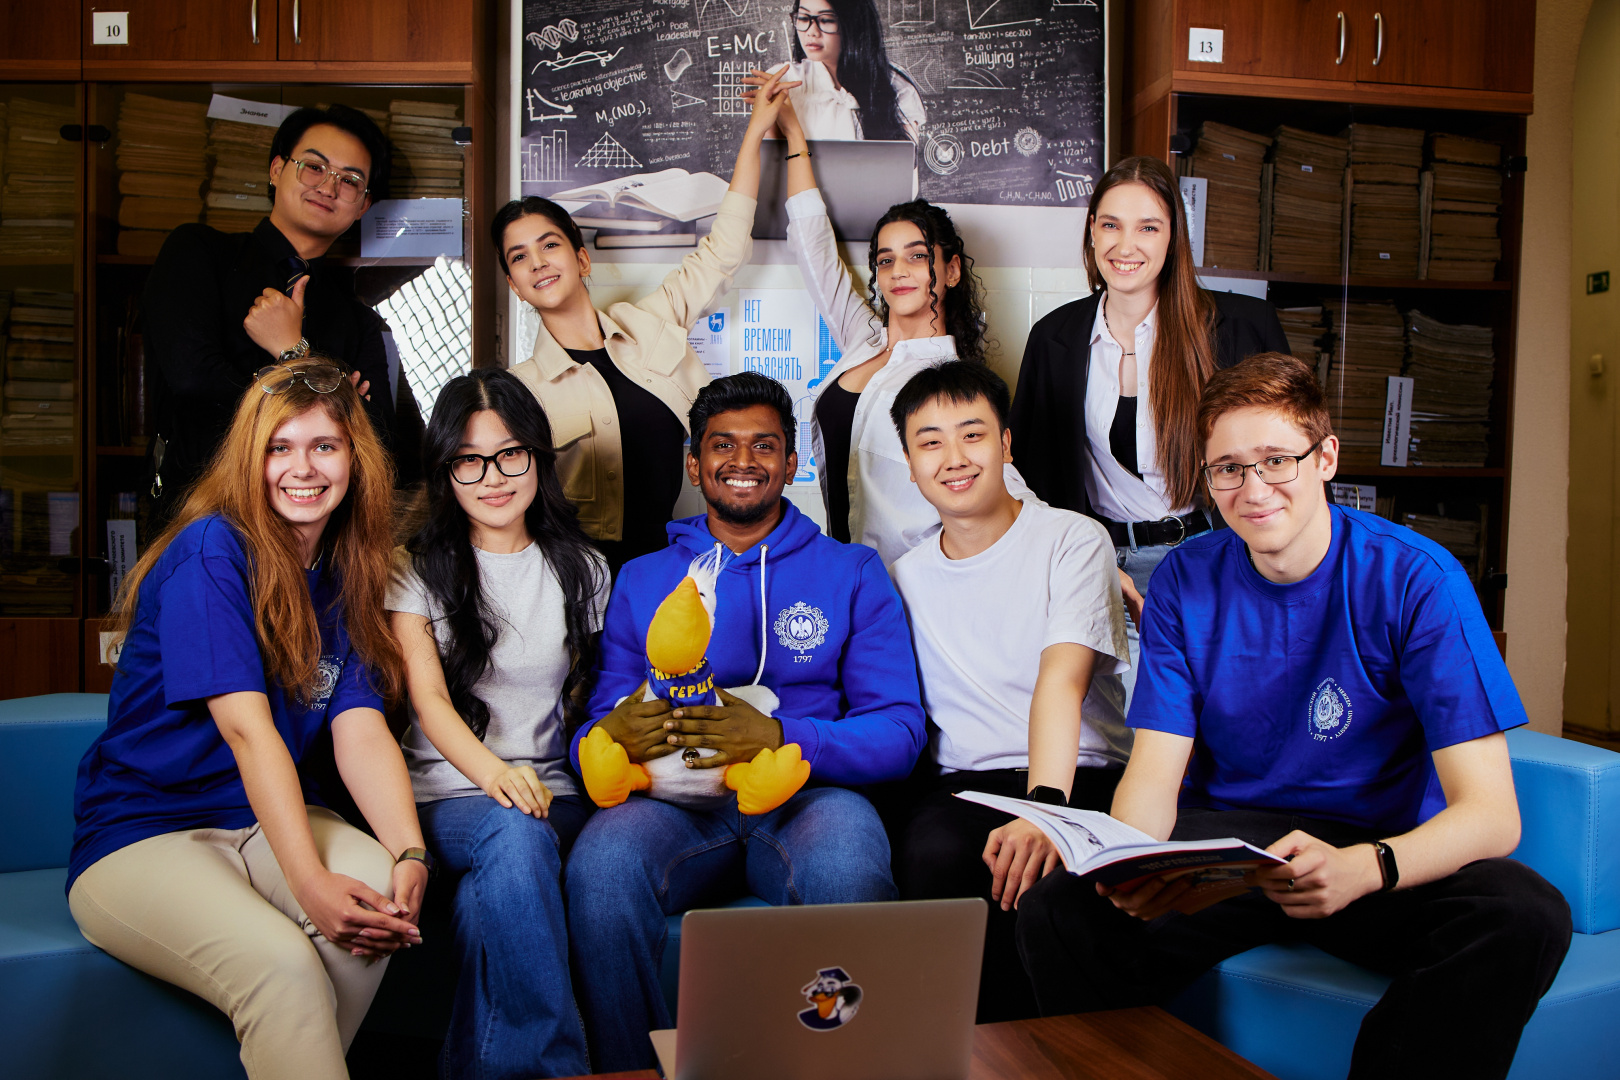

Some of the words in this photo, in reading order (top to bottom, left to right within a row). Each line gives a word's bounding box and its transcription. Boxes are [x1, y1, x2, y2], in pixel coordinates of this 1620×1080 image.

[106, 24, 121, 38] 10
[1199, 41, 1213, 53] 13
[723, 61, 730, 72] A
[965, 51, 1014, 70] Bullying
[603, 70, 648, 92] objective
[240, 108, 269, 117] Знание
[971, 138, 1010, 157] Debt
[744, 299, 762, 322] НЕТ
[744, 328, 791, 352] ВРЕМЕНИ
[744, 357, 802, 381] ОБЪЯСНЯТЬ
[1313, 733, 1327, 742] 1797
